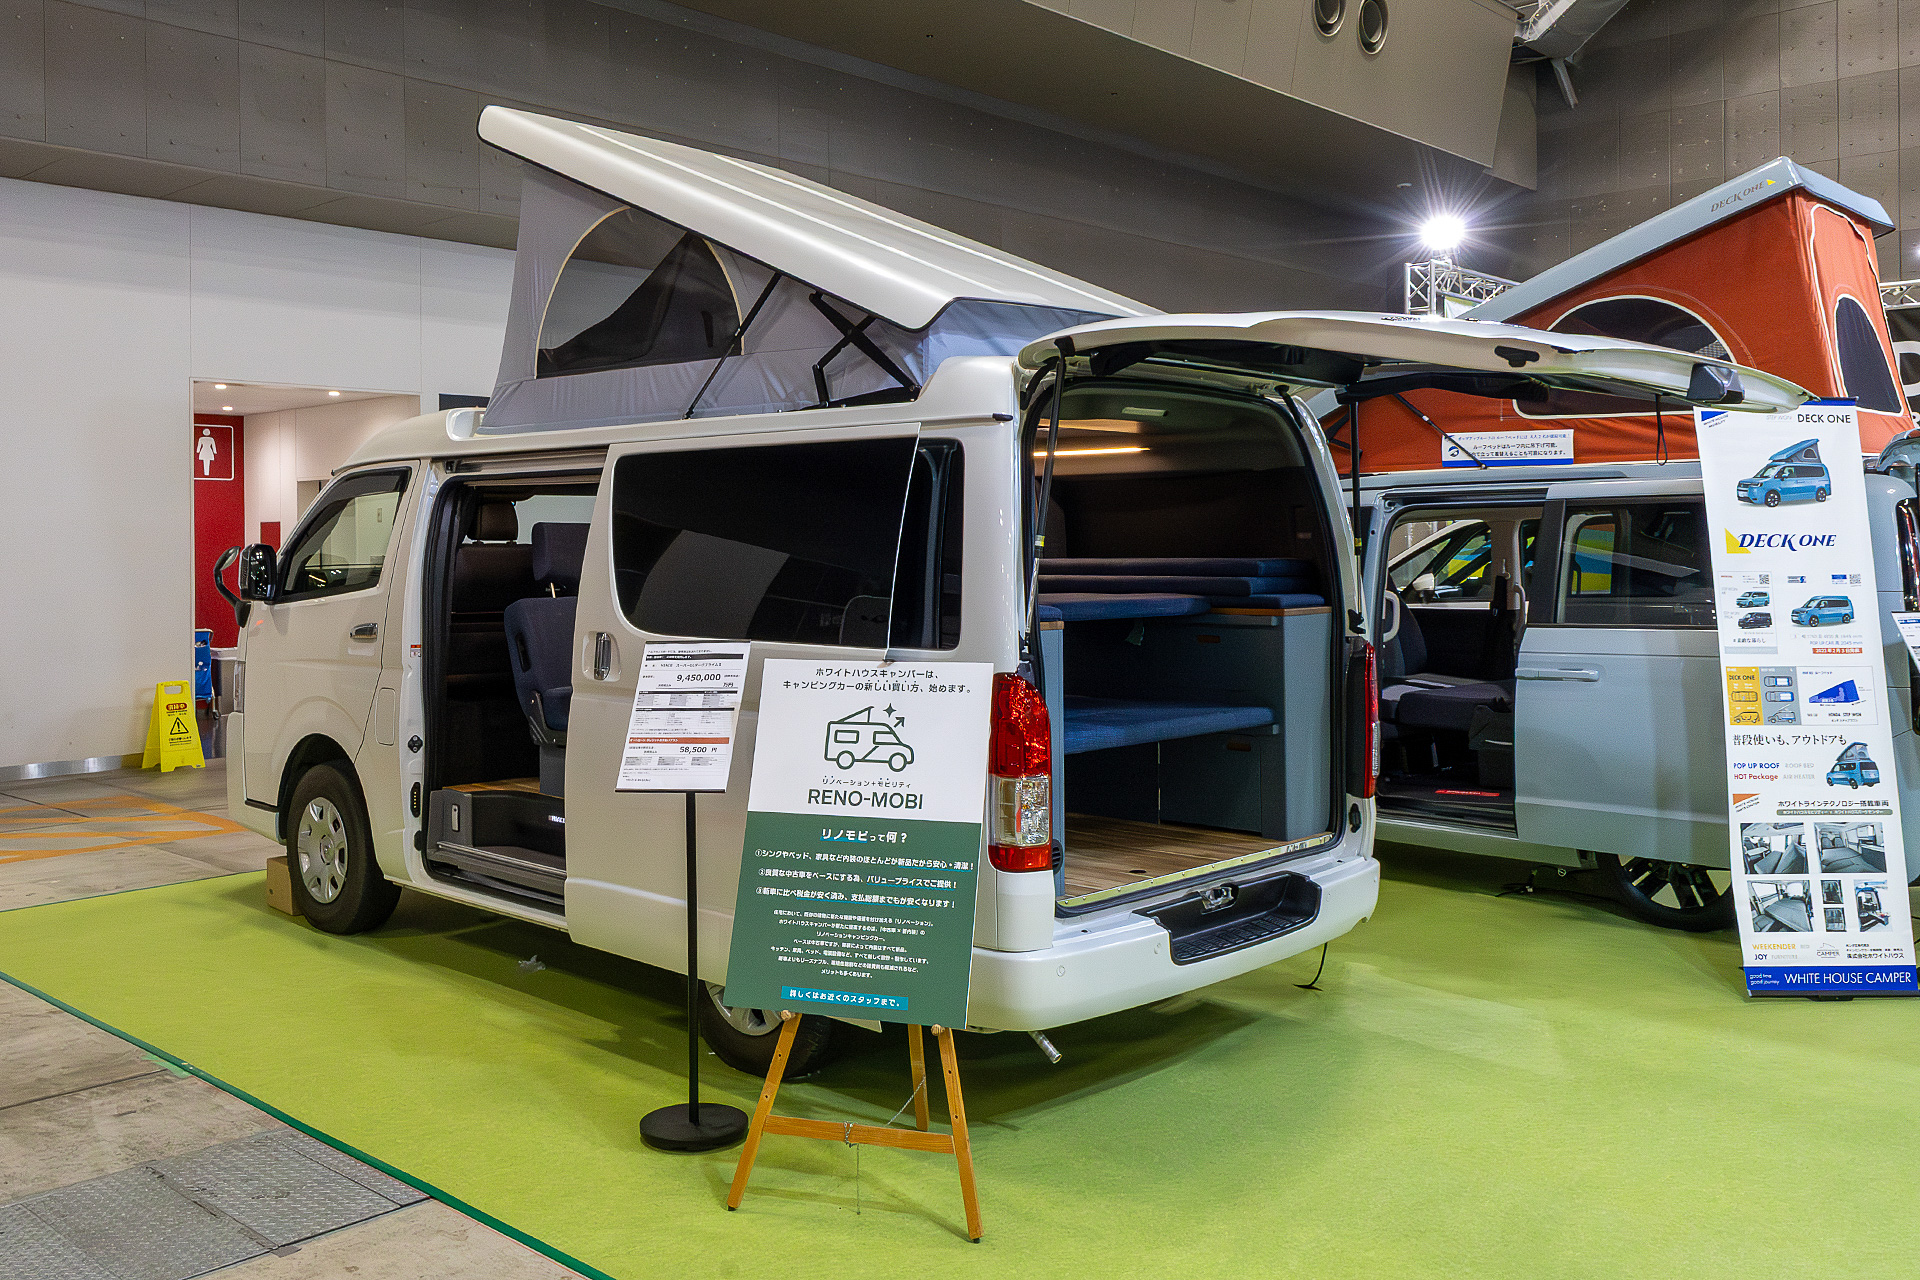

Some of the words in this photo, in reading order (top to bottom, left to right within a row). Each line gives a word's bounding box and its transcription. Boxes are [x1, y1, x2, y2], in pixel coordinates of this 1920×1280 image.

[1710, 191, 1743, 213] DECK
[1797, 413, 1825, 424] DECK
[1827, 414, 1852, 424] ONE
[1737, 533, 1798, 552] DECK
[1799, 534, 1837, 547] ONE
[676, 673, 721, 683] 9,450,000
[782, 680, 972, 694] キャンピングカーの新しい買い方、始めます。
[1732, 734, 1847, 746] 普段使いも、アウトドアも
[680, 746, 707, 754] 58,500
[1749, 773, 1779, 782] Package
[807, 788, 924, 810] RENO-MOBI
[822, 828, 908, 844] リノモビって何？
[1754, 953, 1768, 961] JOY
[1784, 973, 1821, 984] WHITE
[1823, 972, 1863, 984] HOUSE
[1865, 971, 1912, 984] CAMPER
